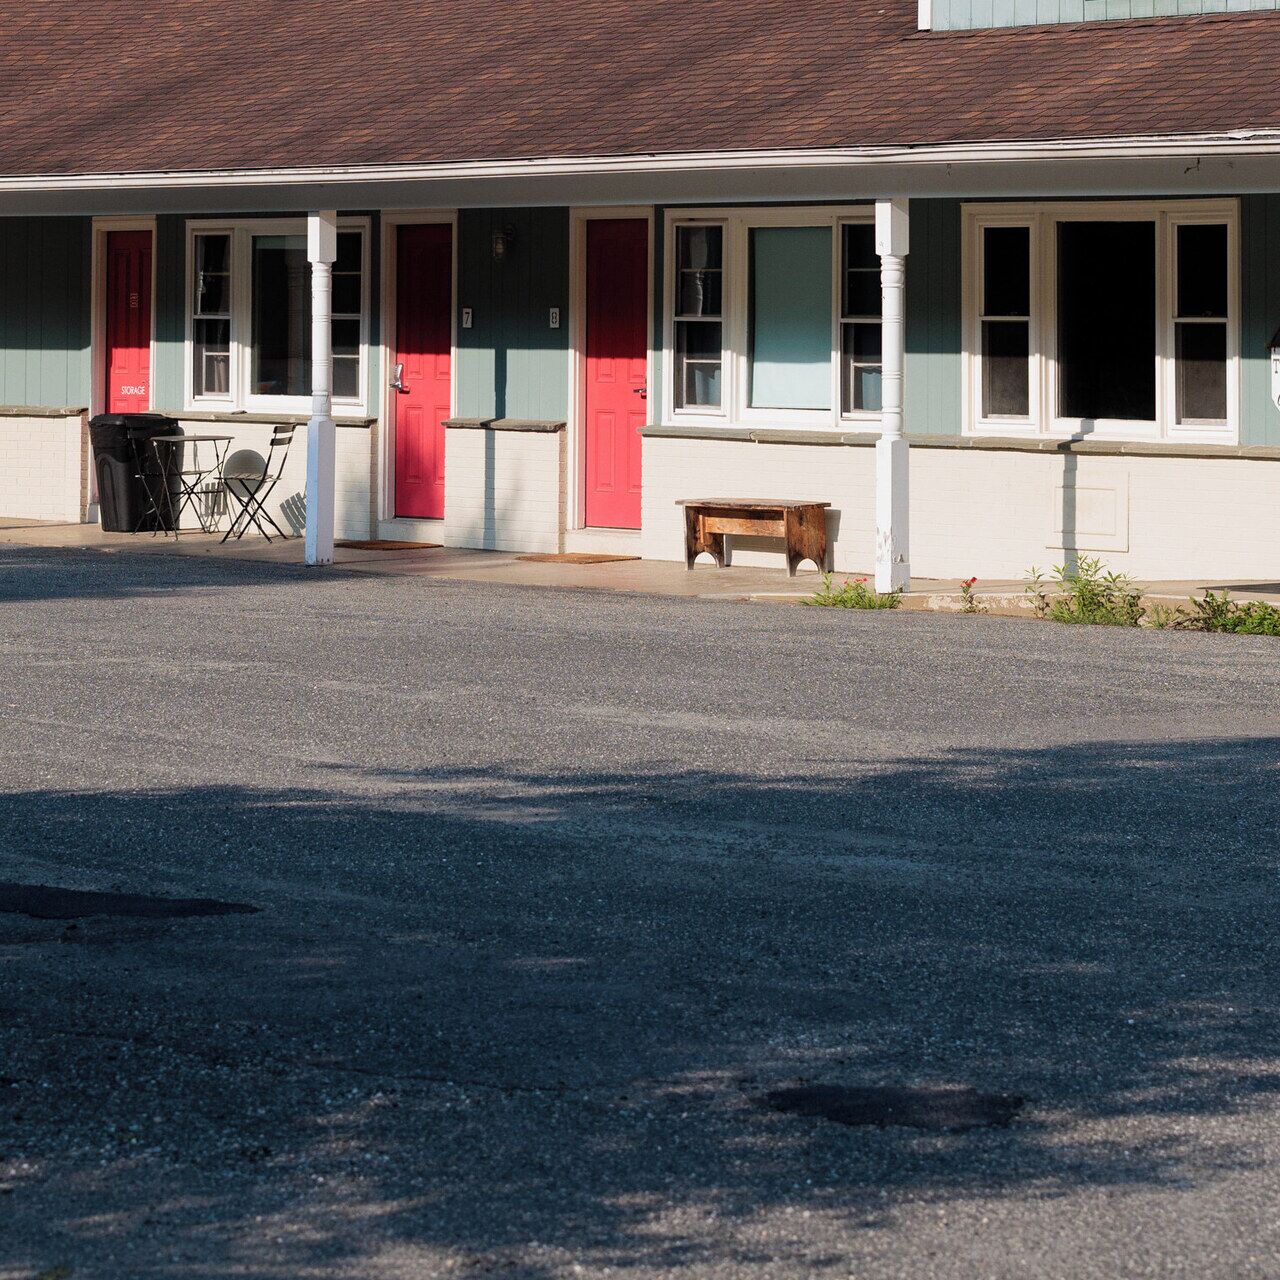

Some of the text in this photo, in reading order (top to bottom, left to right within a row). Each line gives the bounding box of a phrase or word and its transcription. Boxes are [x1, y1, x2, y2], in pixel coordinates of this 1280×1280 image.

[464, 312, 470, 325] 7
[551, 311, 558, 325] 8
[121, 385, 146, 395] STORAGE
